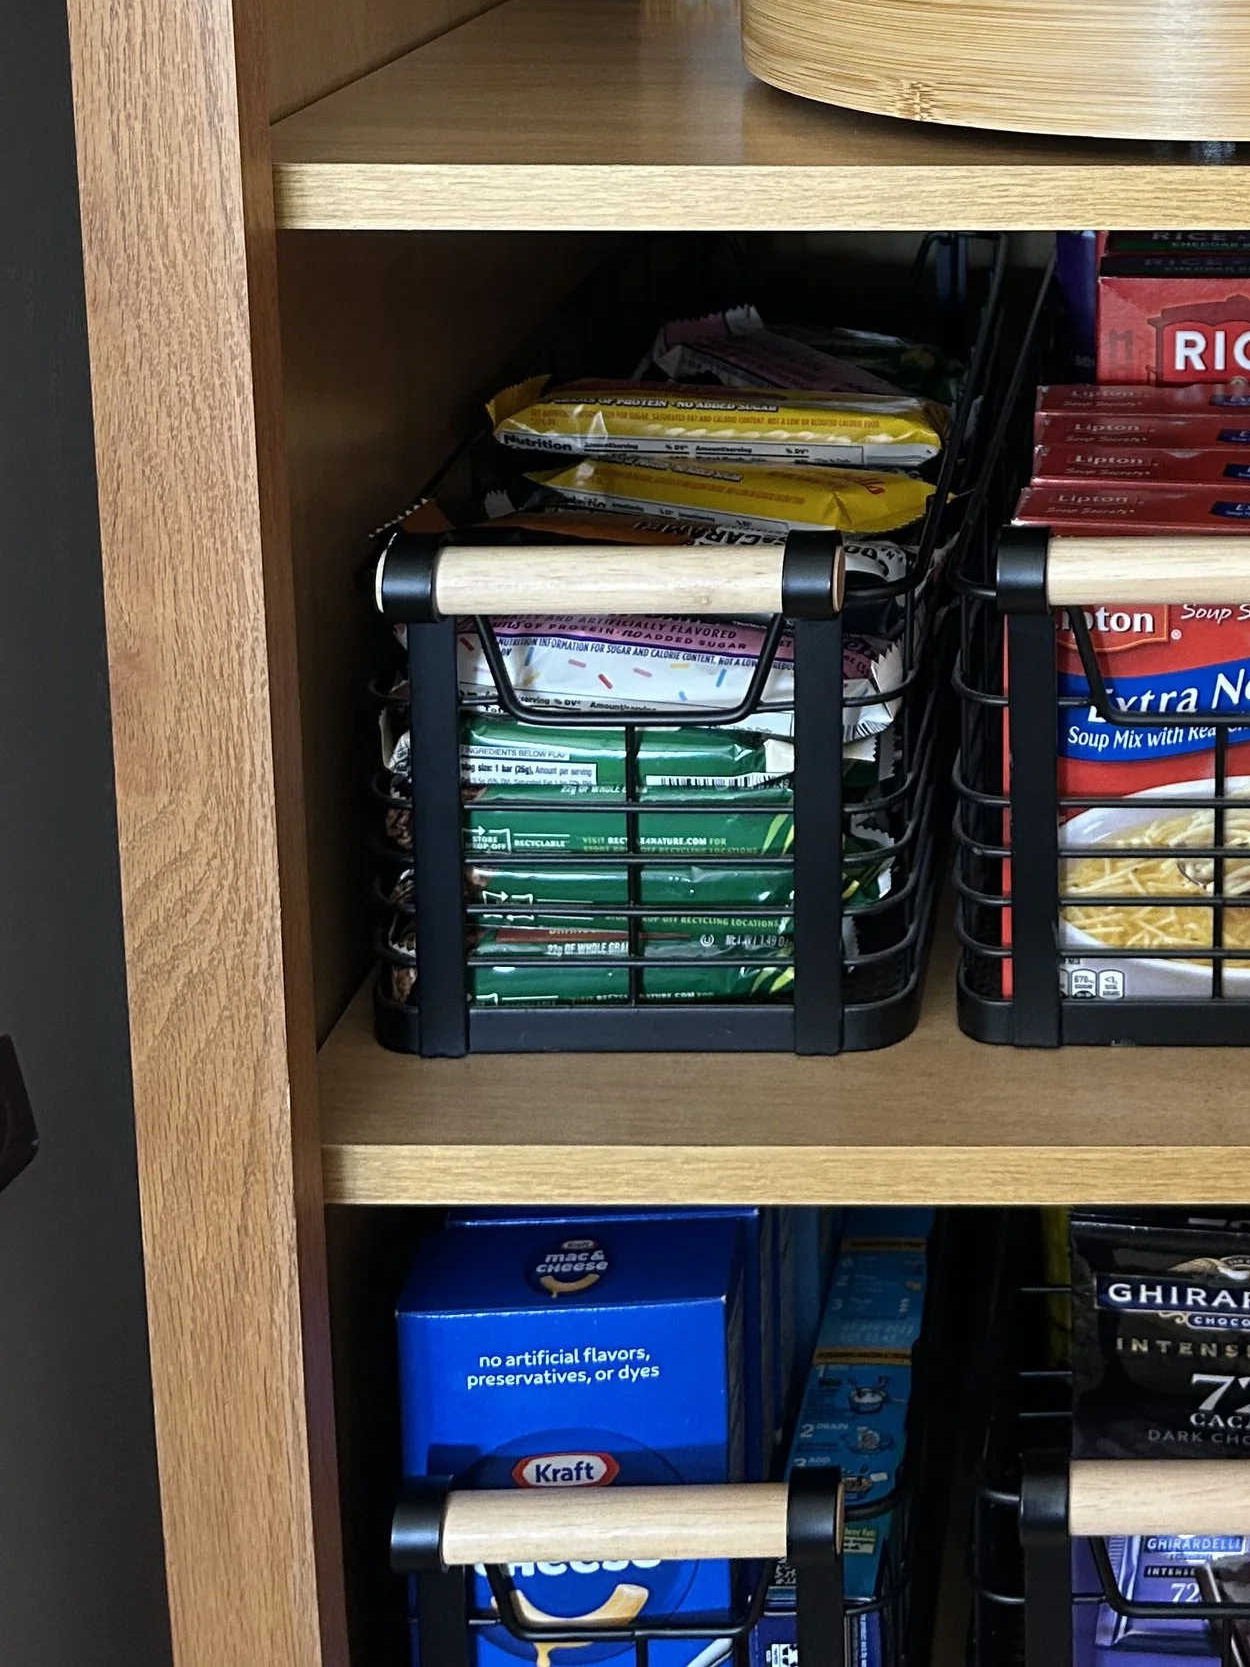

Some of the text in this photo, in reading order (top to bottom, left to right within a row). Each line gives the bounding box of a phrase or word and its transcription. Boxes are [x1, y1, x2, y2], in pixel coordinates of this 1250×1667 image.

[616, 398, 779, 412] PROTEIN NO ADDED SUGAR
[1074, 422, 1141, 432] Lipton
[503, 434, 573, 452] Nutrition
[1075, 455, 1144, 465] Lipton
[1058, 494, 1128, 503] Lipton
[1181, 602, 1232, 622] Soup
[523, 621, 540, 629] OF
[549, 623, 615, 635] PROTEIN
[643, 631, 692, 645] ADDED
[698, 639, 748, 650] SUGAR
[578, 617, 737, 640] ARTIFICIALLY FLAVORED
[538, 637, 590, 653] INFORMATION
[590, 644, 604, 654] FOR
[606, 646, 632, 656] SUGAR
[632, 648, 649, 657] AND
[650, 649, 681, 661] CALORIE
[718, 657, 733, 666] NOT
[734, 658, 741, 666] A
[1067, 724, 1184, 752] Soup Mix with
[518, 748, 547, 759] BELOW
[535, 765, 557, 775] Amount
[514, 839, 566, 848] RECYCLABLE
[680, 915, 779, 928] RECYCLING LOCATIONS
[546, 943, 608, 956] 22g OF WHOLE
[545, 1249, 605, 1263] mac &
[478, 1345, 651, 1368] no artificial flavors,
[466, 1364, 660, 1390] preservatives, or dyes
[800, 1423, 815, 1438] 2
[1146, 1428, 1203, 1445] DARK
[534, 1461, 595, 1483] Kraft
[1146, 1537, 1241, 1551] GHIRARDELLI
[1170, 1582, 1204, 1603] 72
